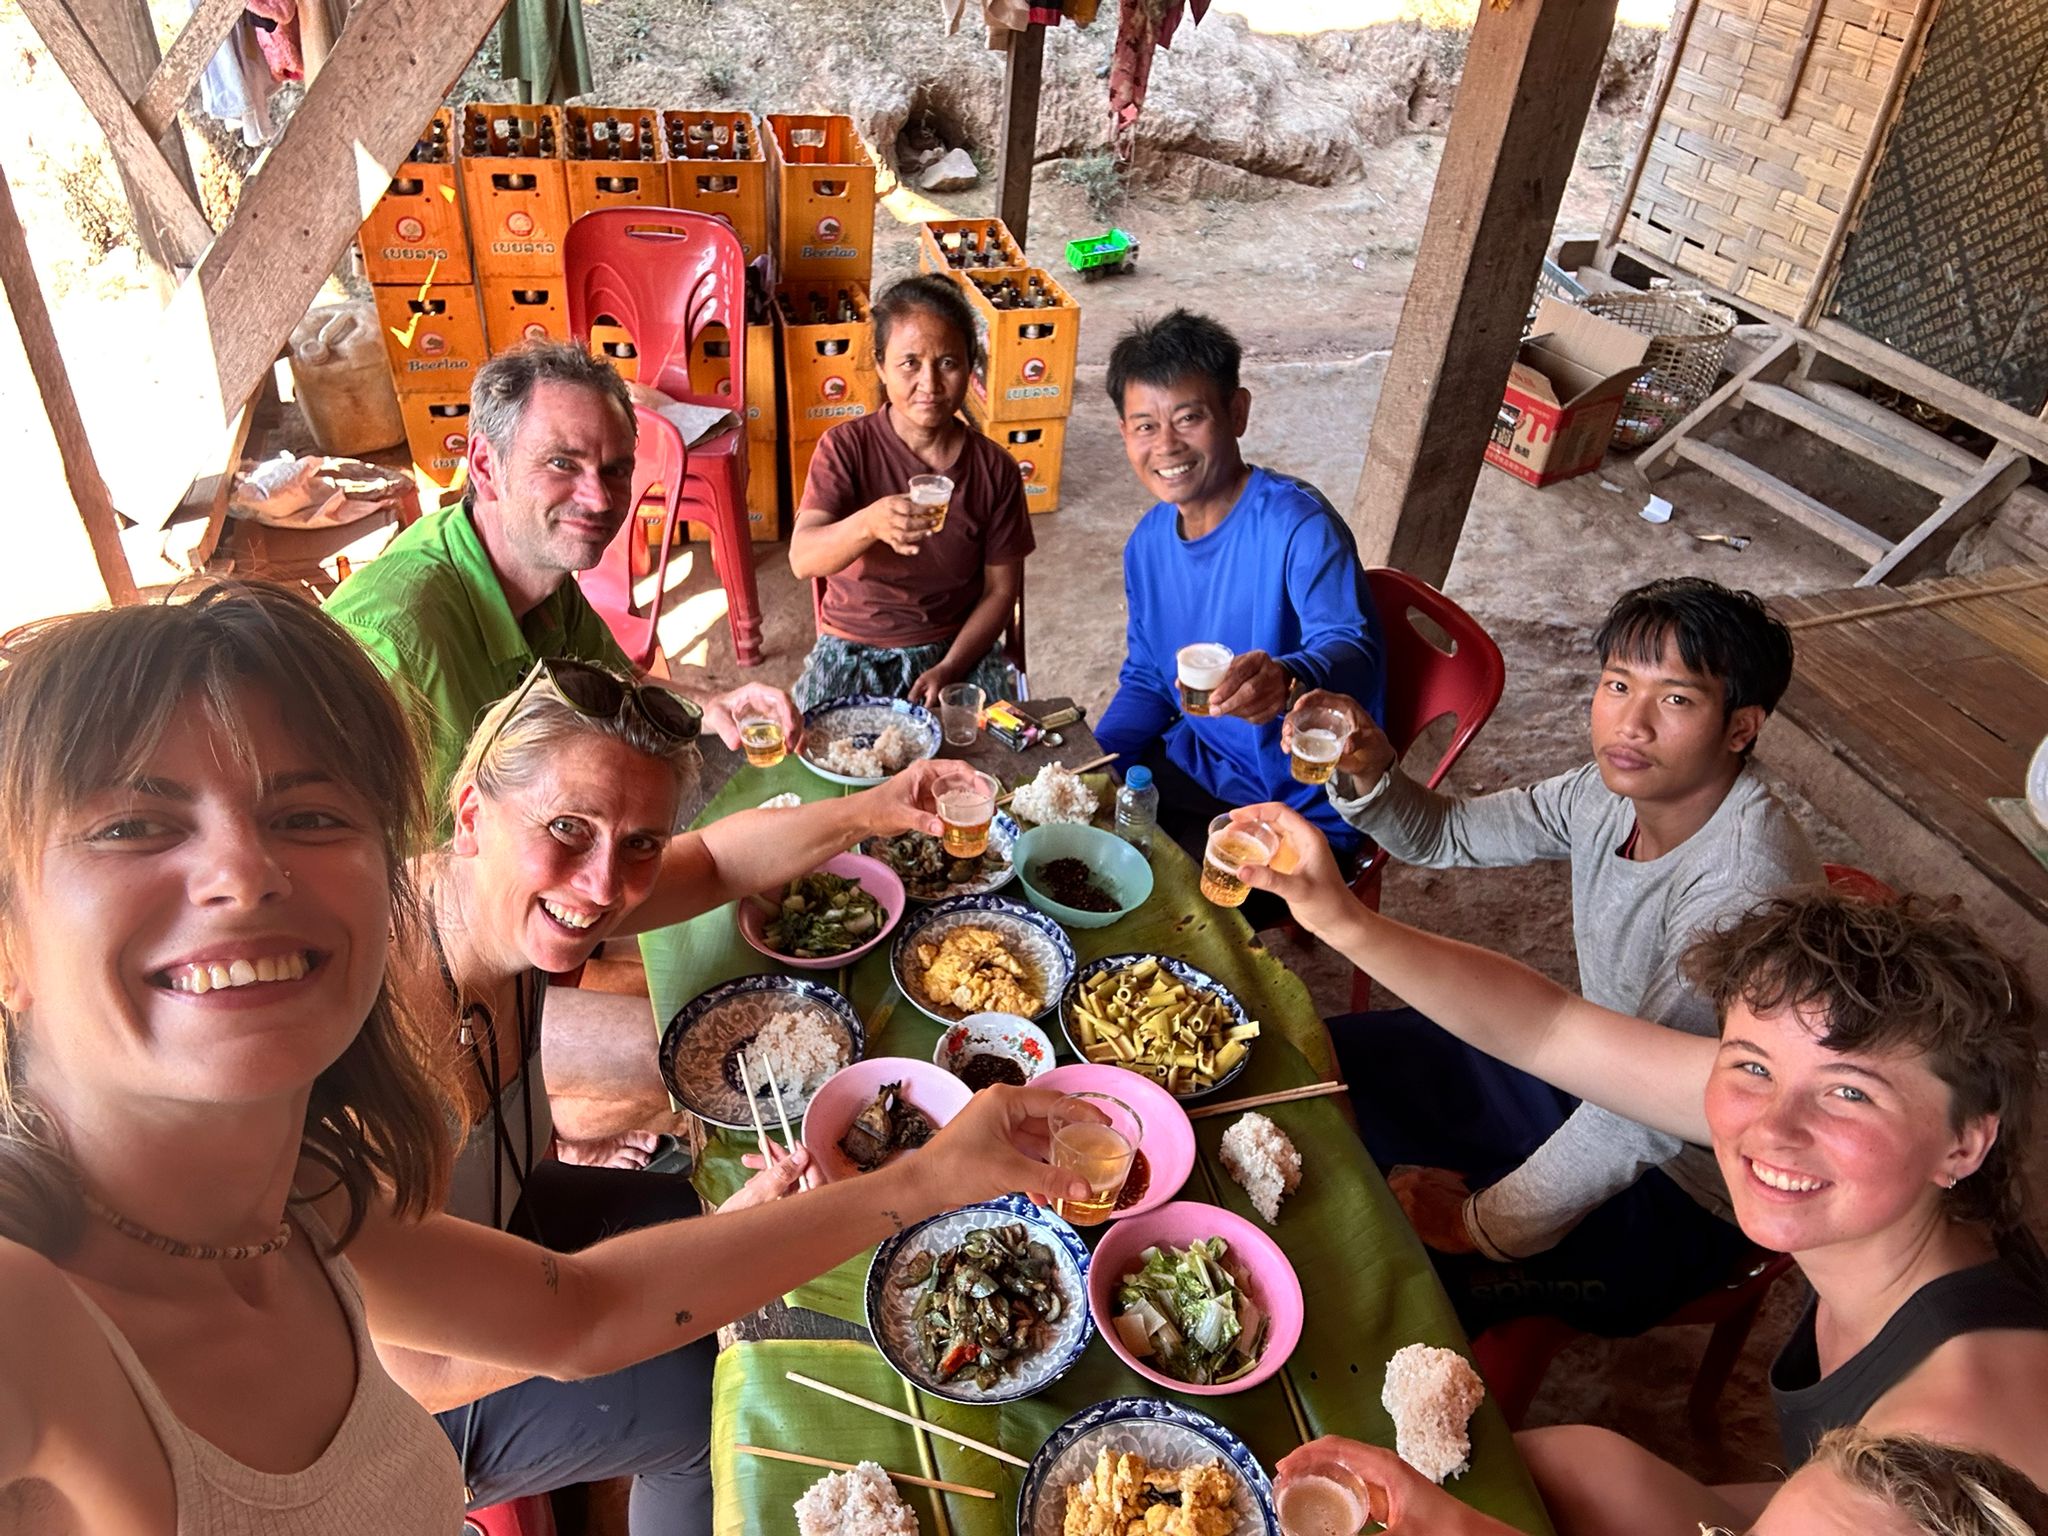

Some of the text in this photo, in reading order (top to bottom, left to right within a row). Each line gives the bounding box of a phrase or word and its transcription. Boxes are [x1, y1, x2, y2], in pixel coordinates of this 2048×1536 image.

[1897, 86, 1982, 145] SUPERPLEX
[1903, 70, 1978, 124] SUPERPLE
[1899, 102, 1985, 160] SUPERPLEX
[1907, 134, 1991, 190] SUPERPLEX
[1957, 174, 2047, 232] SUPERPLEX
[802, 245, 858, 259] Beerlao
[1968, 230, 2047, 278] UPERPLEX
[408, 358, 469, 372] Beerlao
